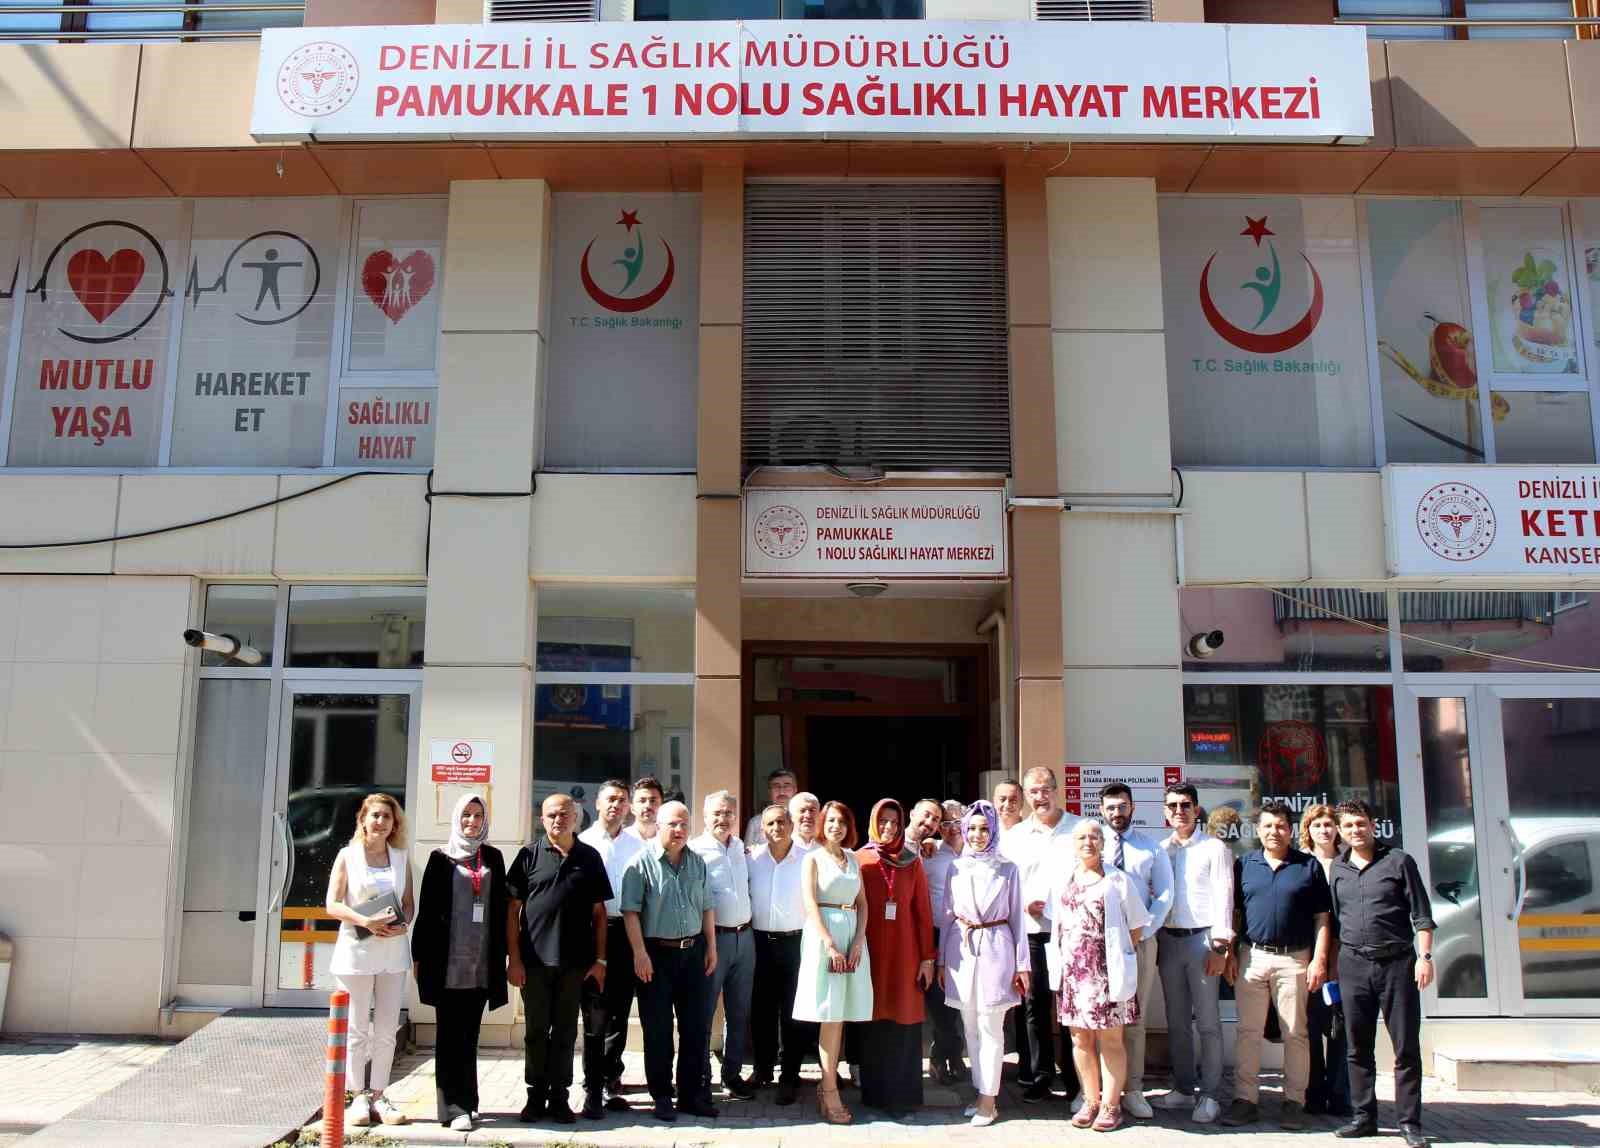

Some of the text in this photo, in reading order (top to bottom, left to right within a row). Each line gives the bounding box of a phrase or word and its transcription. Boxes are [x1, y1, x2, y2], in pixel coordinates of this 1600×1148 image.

[379, 34, 1010, 71] DENİZLİ İL SAĞLIK MÜDÜRLÜĞÜ
[375, 75, 1321, 119] PAMUKKALE 1 NOLU SAĞLIKLI HAYAT MERKEZİ
[594, 316, 627, 329] Sağlık
[631, 316, 683, 329] Bakanlığı
[39, 360, 154, 390] MUTLU
[1223, 359, 1270, 375] Sağlık
[1274, 359, 1342, 376] Bakanlığı
[195, 371, 311, 397] HAREKET
[234, 408, 266, 432] ET
[348, 396, 431, 425] SAĞLIKLI
[52, 406, 133, 447] YAŞA
[359, 436, 416, 459] HAYAT
[1519, 475, 1600, 499] DENİZLİ İ
[816, 504, 981, 520] DENİZLİ İL SAĞLIK MÜDÜRLÜĞÜ
[816, 527, 894, 541] PAMUKKALE
[817, 544, 995, 561] 1 NOLU SAĞLIKLI HAYAT MERKEZİ
